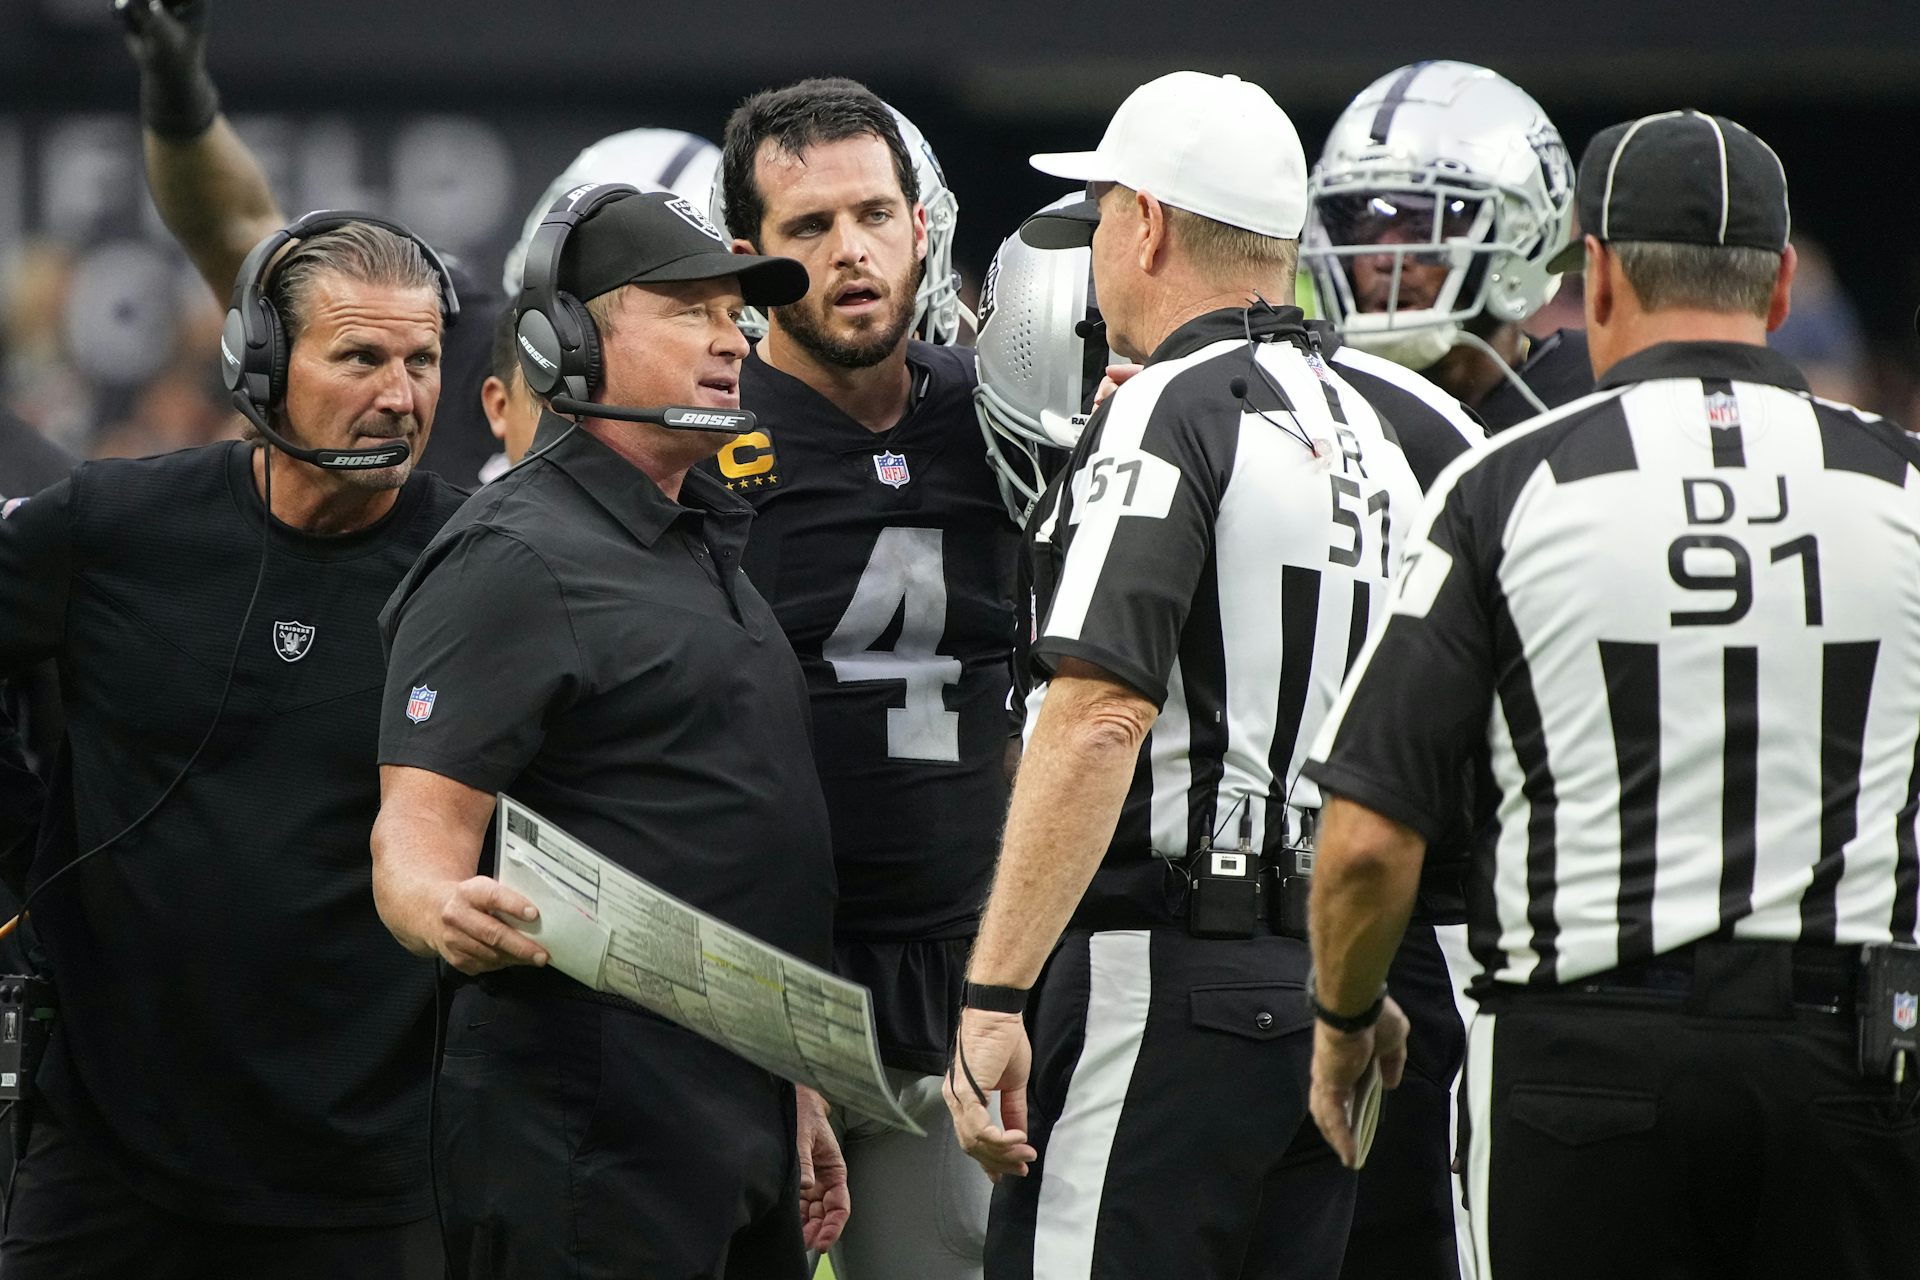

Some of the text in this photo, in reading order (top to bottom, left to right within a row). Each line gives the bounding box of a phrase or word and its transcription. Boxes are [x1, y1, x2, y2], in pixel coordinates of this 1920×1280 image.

[518, 333, 557, 368] BOSE
[669, 412, 745, 427] BOSE
[1708, 406, 1739, 425] NFL
[322, 452, 397, 466] BOSE
[717, 431, 775, 479] C
[1334, 427, 1368, 479] R
[882, 465, 908, 482] NFL
[1087, 457, 1143, 507] 51
[1329, 474, 1391, 578] 51
[1668, 533, 1823, 628] 91
[279, 624, 310, 635] RAIDERS
[822, 527, 963, 762] 4
[409, 700, 429, 718] NFL
